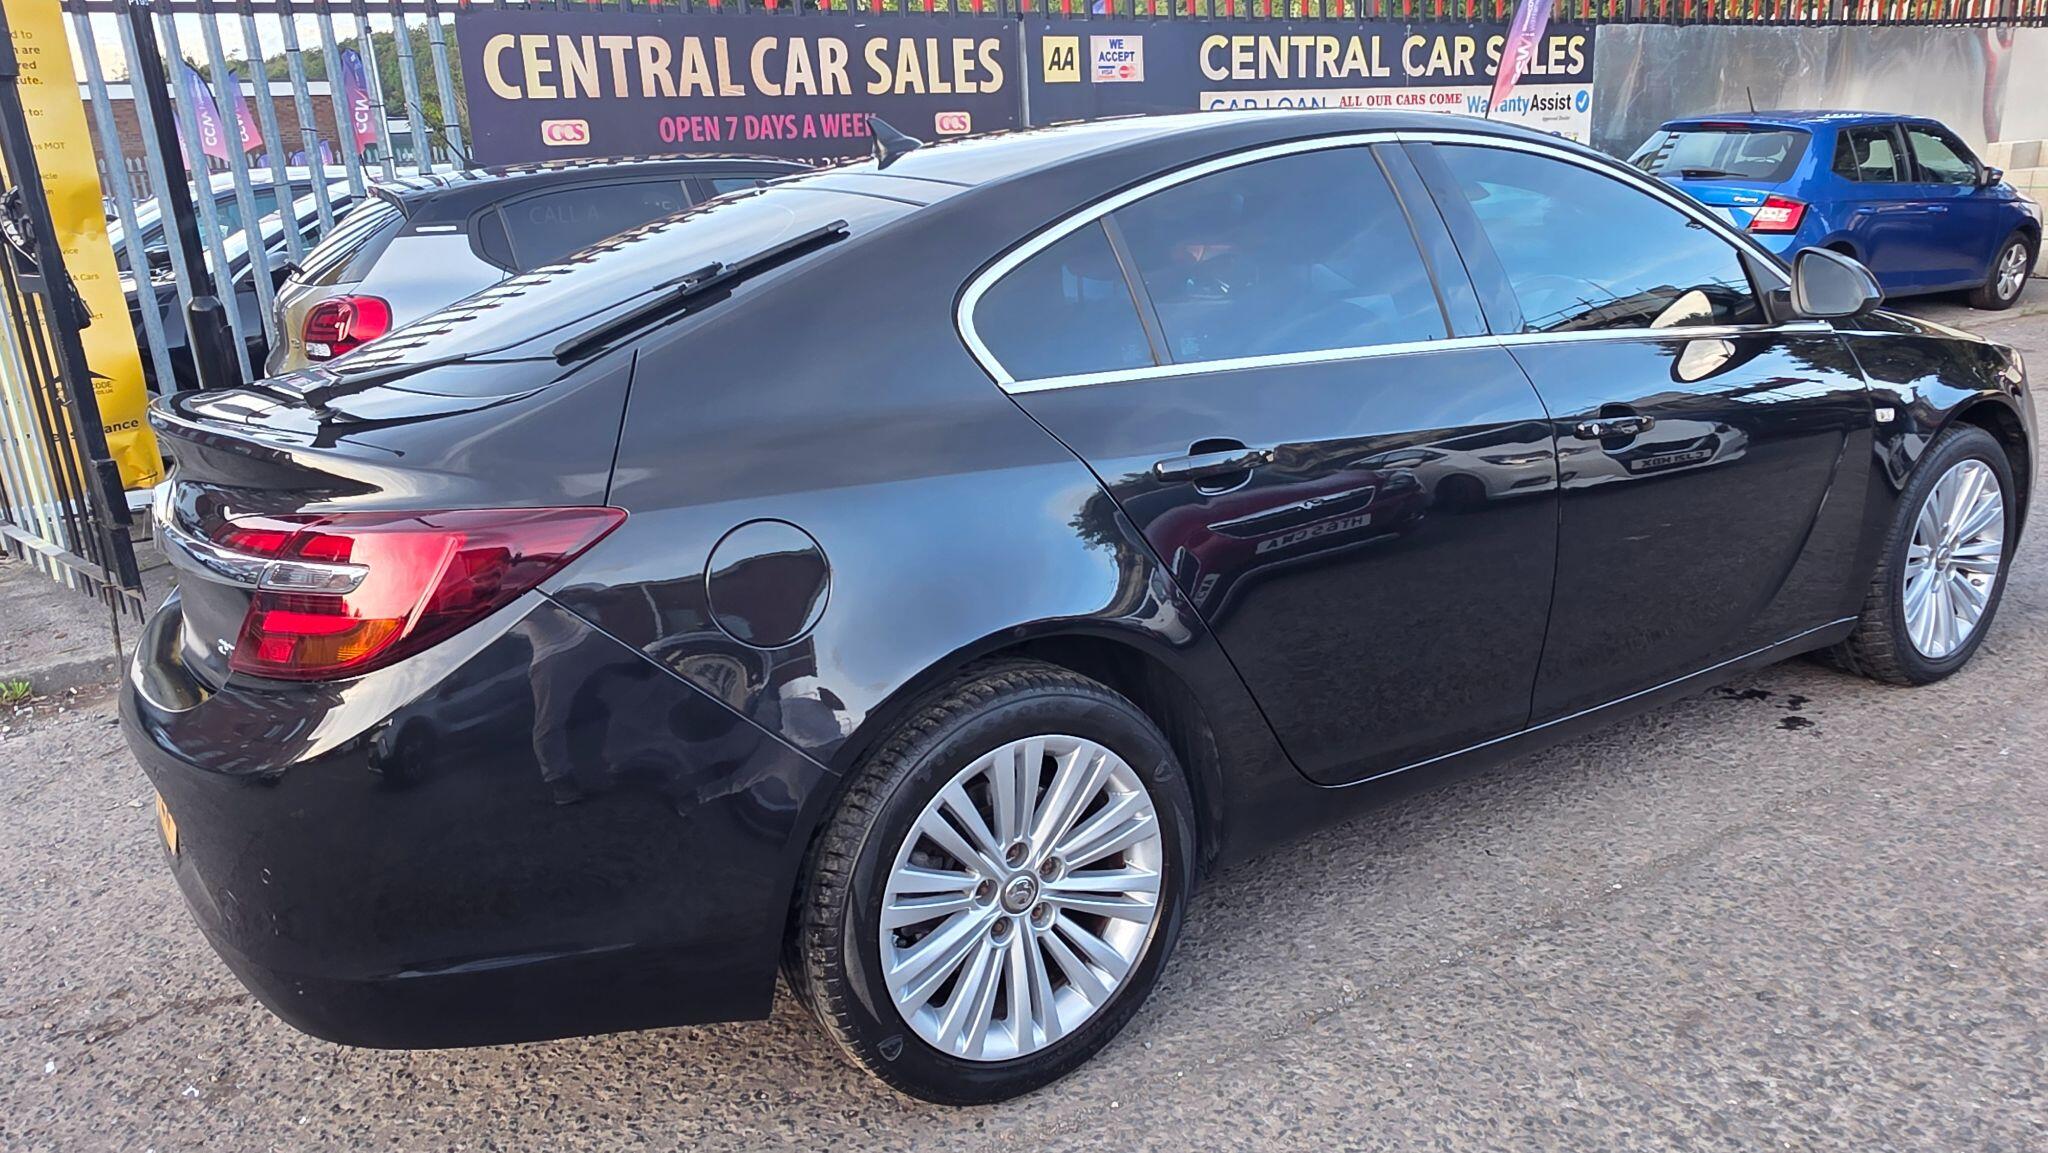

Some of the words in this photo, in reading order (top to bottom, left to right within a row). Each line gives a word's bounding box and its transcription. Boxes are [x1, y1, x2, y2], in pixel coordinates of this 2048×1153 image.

[21, 47, 41, 55] are
[1109, 39, 1124, 49] WE
[1048, 46, 1075, 71] AA
[1098, 51, 1136, 62] ACCEPT
[1199, 35, 1391, 80] CENTRAL
[1402, 35, 1476, 77] CAR
[483, 33, 746, 100] CENTRAL
[750, 36, 853, 97] CAR
[864, 37, 1004, 95] SALES
[1339, 95, 1362, 107] ALL
[1367, 95, 1392, 106] OUR
[1396, 94, 1426, 105] CARS
[1430, 93, 1463, 105] COME
[659, 116, 720, 144] OPEN
[724, 116, 738, 141] 7
[744, 113, 797, 140] DAYS
[803, 114, 817, 138] A
[44, 142, 65, 150] MOT
[80, 273, 99, 281] Cars
[104, 419, 139, 433] ance
